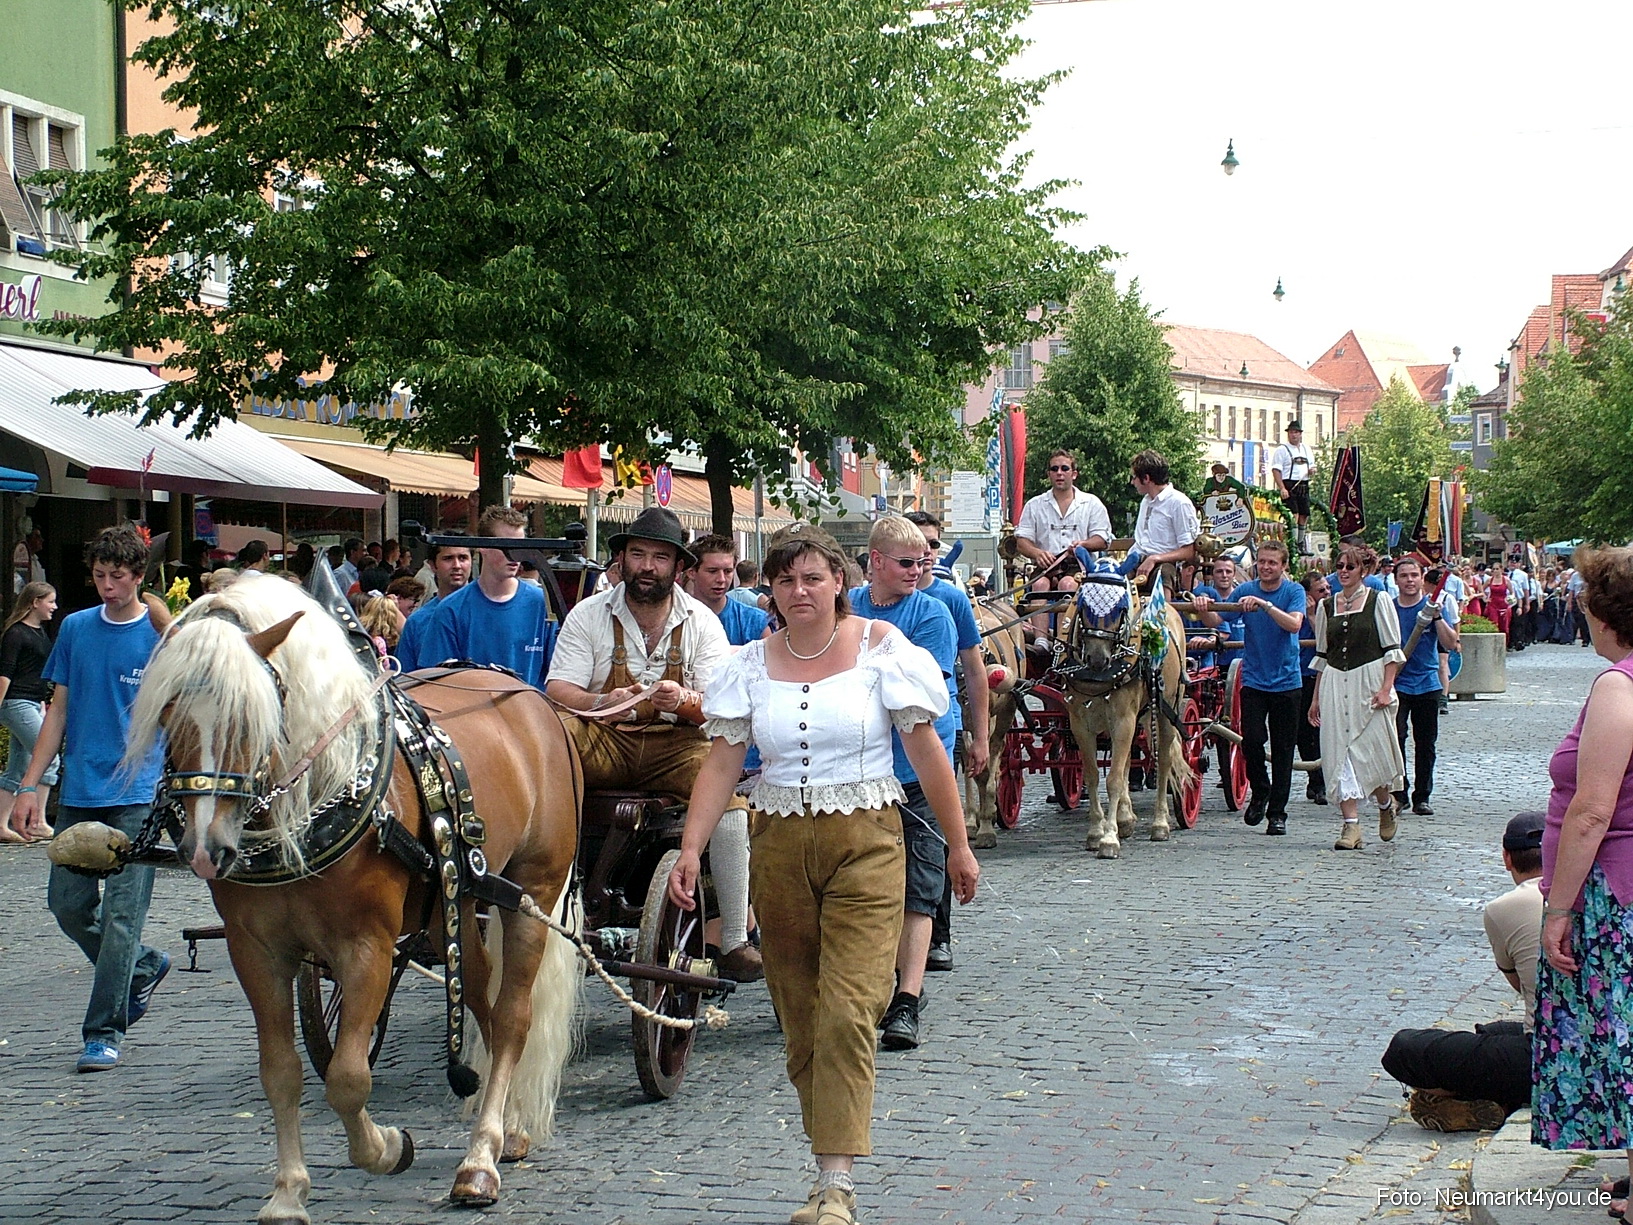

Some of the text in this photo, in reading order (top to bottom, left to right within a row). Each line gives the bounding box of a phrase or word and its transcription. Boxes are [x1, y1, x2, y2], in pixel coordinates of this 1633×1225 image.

[0, 275, 42, 321] erl
[991, 489, 998, 506] P
[1231, 521, 1249, 530] Bier
[120, 674, 141, 686] Krupp
